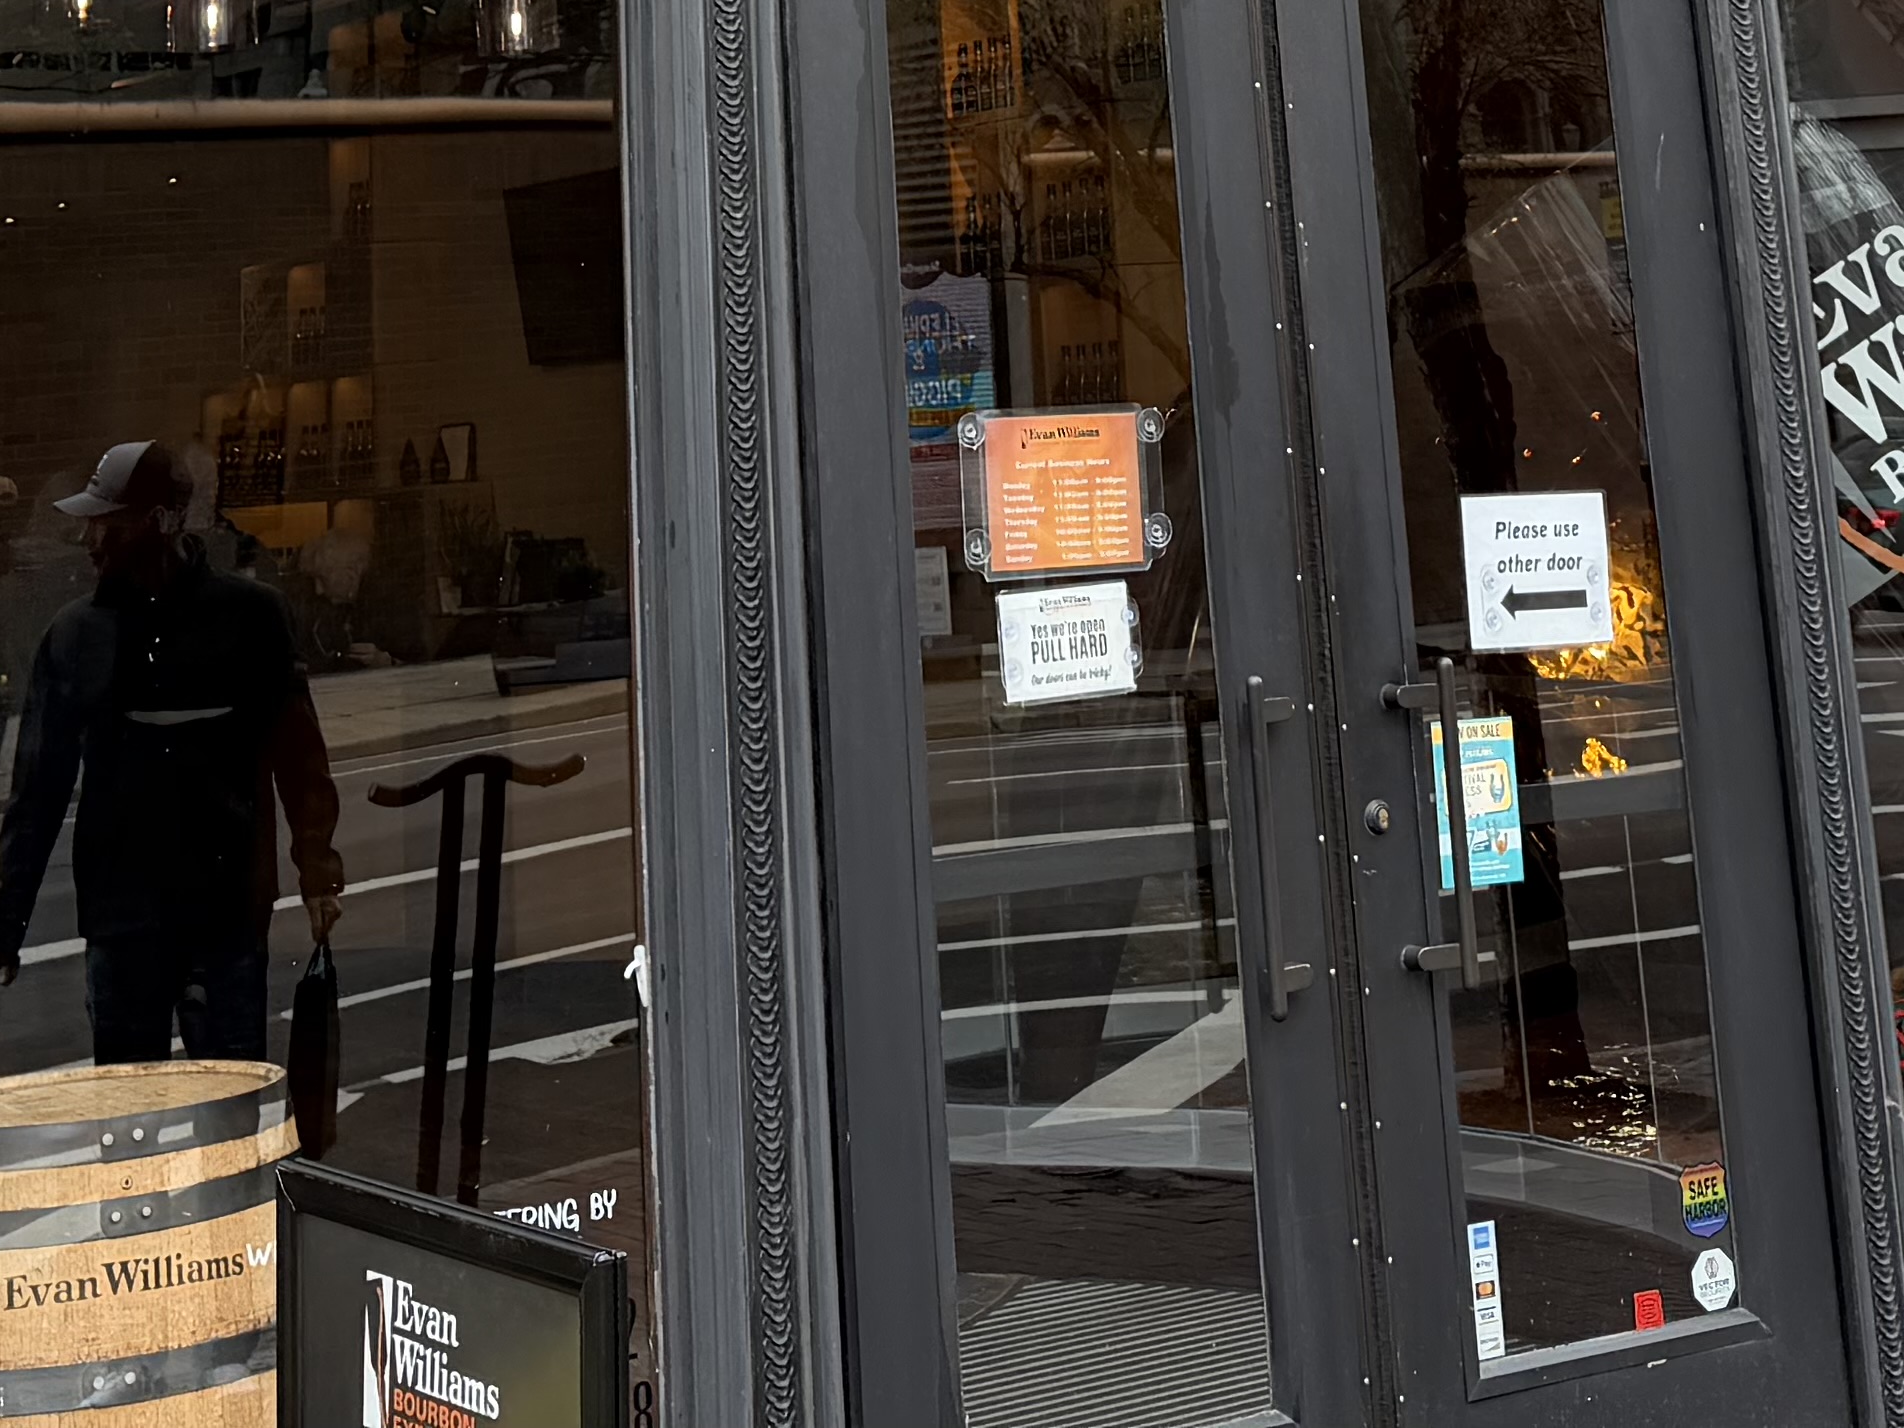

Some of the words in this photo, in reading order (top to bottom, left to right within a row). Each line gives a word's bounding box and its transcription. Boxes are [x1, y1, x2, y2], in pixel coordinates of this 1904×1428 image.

[1494, 520, 1548, 542] Please
[1553, 520, 1580, 539] use
[1496, 552, 1542, 575] other
[1546, 551, 1583, 572] door
[1030, 623, 1050, 639] Yes
[1051, 621, 1078, 637] we're
[1080, 620, 1106, 639] open
[1030, 639, 1066, 665] PULL
[1069, 632, 1109, 661] HARD
[1687, 1174, 1718, 1201] SAFE
[589, 1188, 618, 1221] BY
[1684, 1196, 1727, 1223] HARBOR
[2, 1273, 101, 1311] Evan
[101, 1250, 246, 1295] Williams
[394, 1280, 460, 1349] Evan
[392, 1334, 501, 1421] Williams
